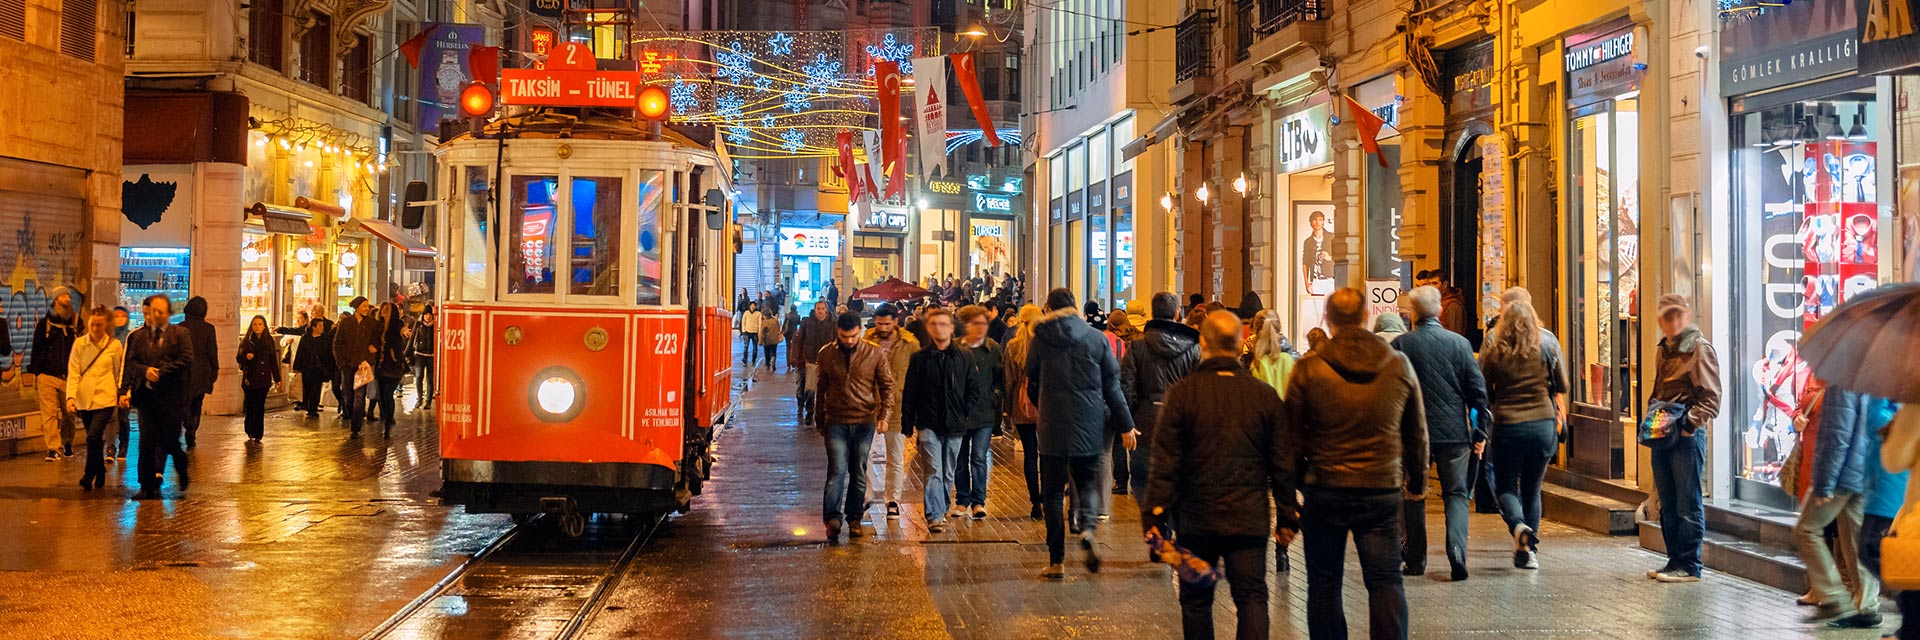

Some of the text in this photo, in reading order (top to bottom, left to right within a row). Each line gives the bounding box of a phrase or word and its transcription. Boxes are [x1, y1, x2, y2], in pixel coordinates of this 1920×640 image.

[566, 44, 577, 65] 2
[1565, 32, 1634, 72] TOMMY HILFIGER
[1732, 39, 1858, 83] GÖMLEK KRALLIĞI
[509, 76, 560, 97] TAKSİM
[586, 77, 635, 98] TÜNEL
[1281, 118, 1302, 164] LTB
[446, 328, 465, 350] 223
[655, 333, 677, 354] 223
[641, 418, 650, 427] VE
